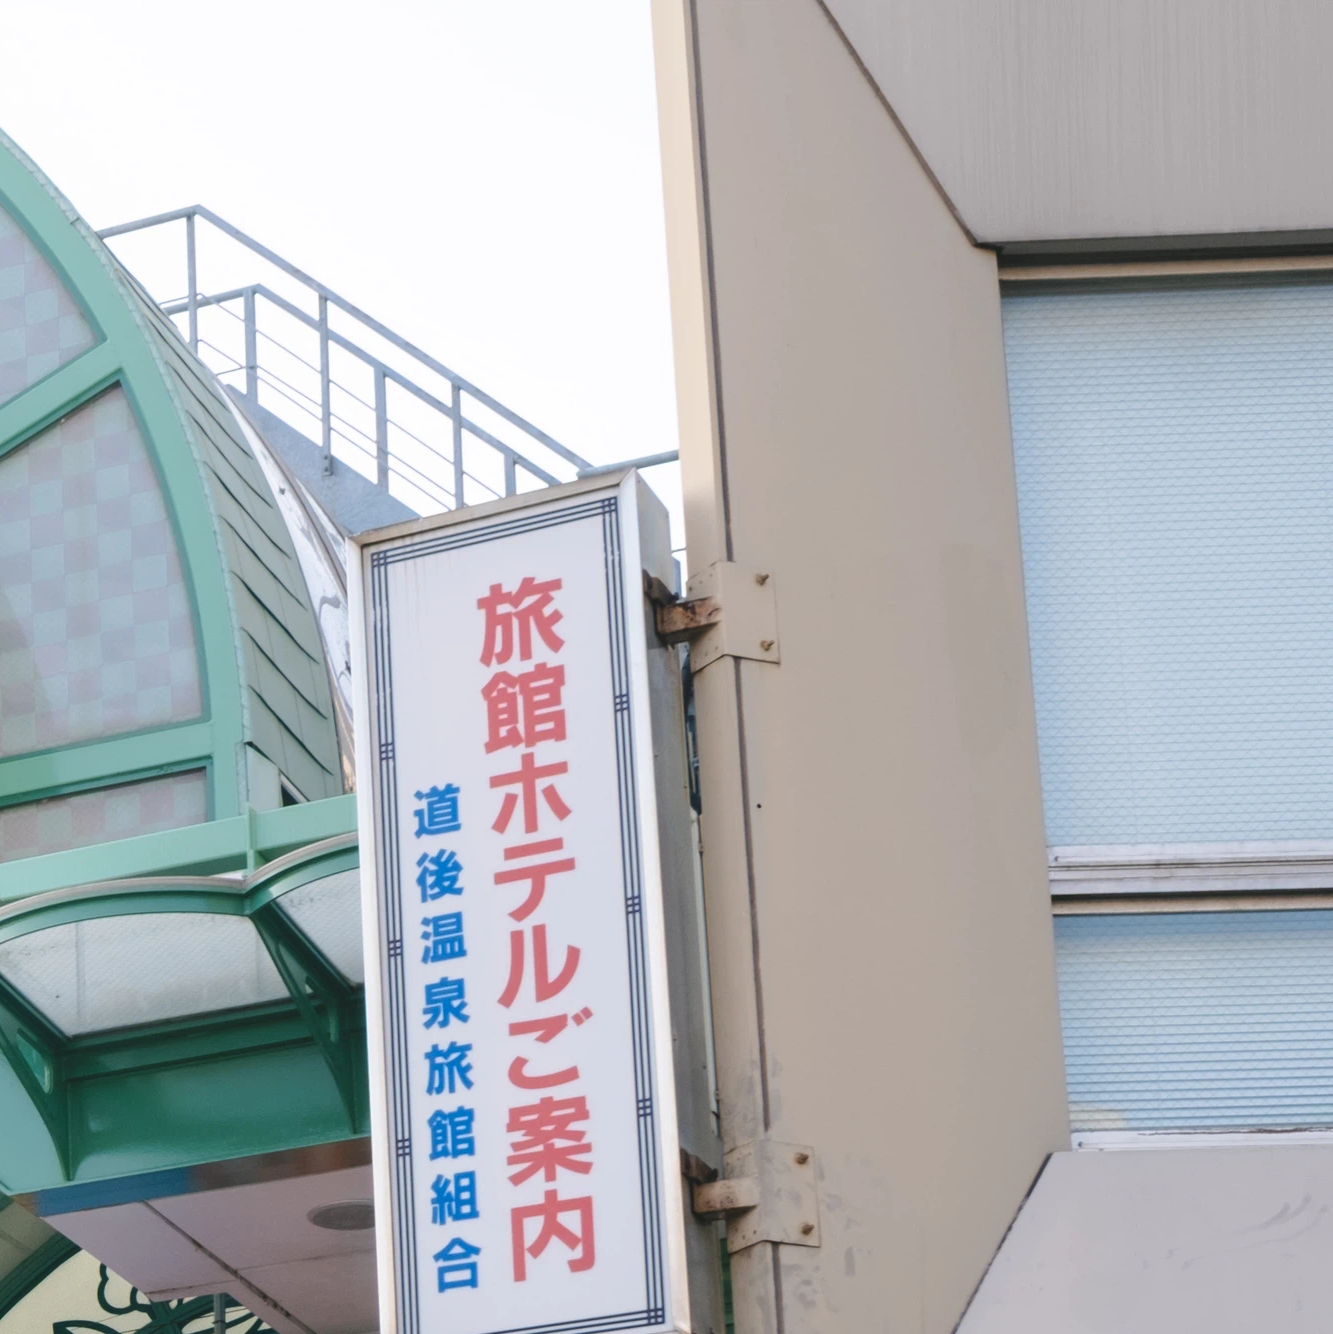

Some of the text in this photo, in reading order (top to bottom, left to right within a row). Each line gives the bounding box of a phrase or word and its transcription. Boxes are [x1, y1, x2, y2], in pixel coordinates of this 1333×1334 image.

[411, 783, 483, 1295] 道後温泉旅館組合
[476, 574, 597, 1284] 旅館ホテルご案内
